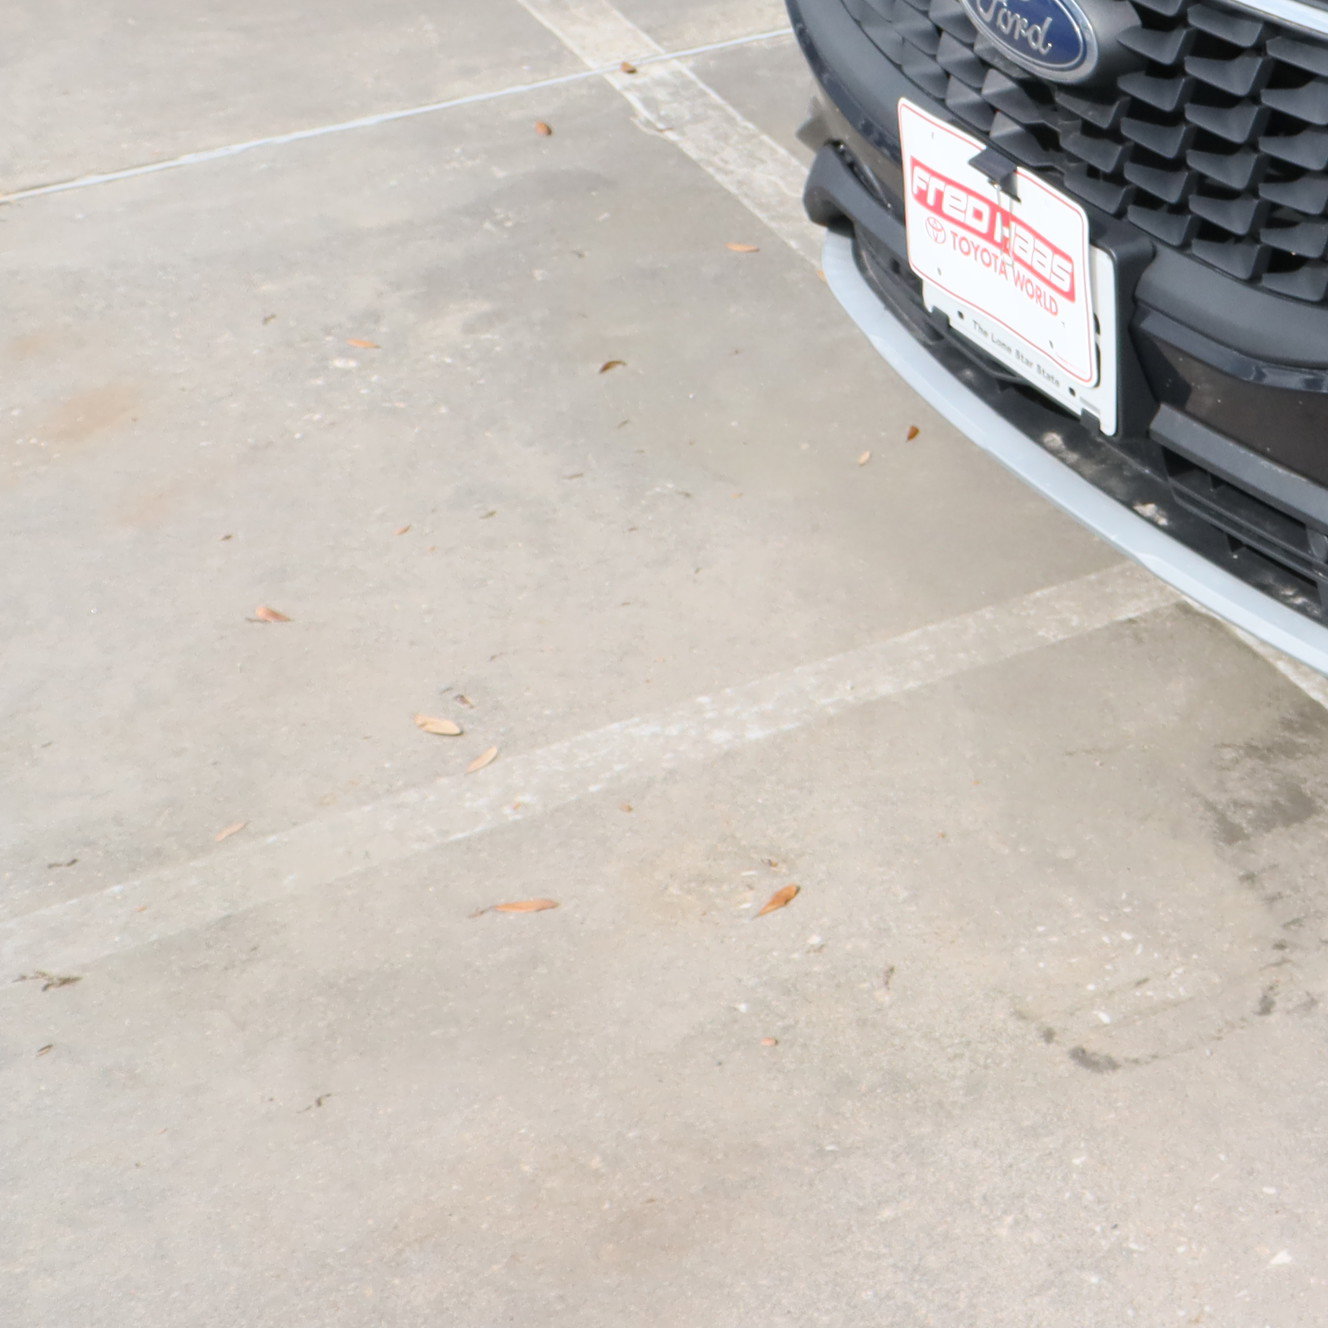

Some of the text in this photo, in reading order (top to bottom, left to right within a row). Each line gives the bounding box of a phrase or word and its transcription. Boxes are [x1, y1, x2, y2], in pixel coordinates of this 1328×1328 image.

[950, 231, 1058, 316] TOYOTA WORLD
[973, 319, 1060, 388] The Lone Star State
